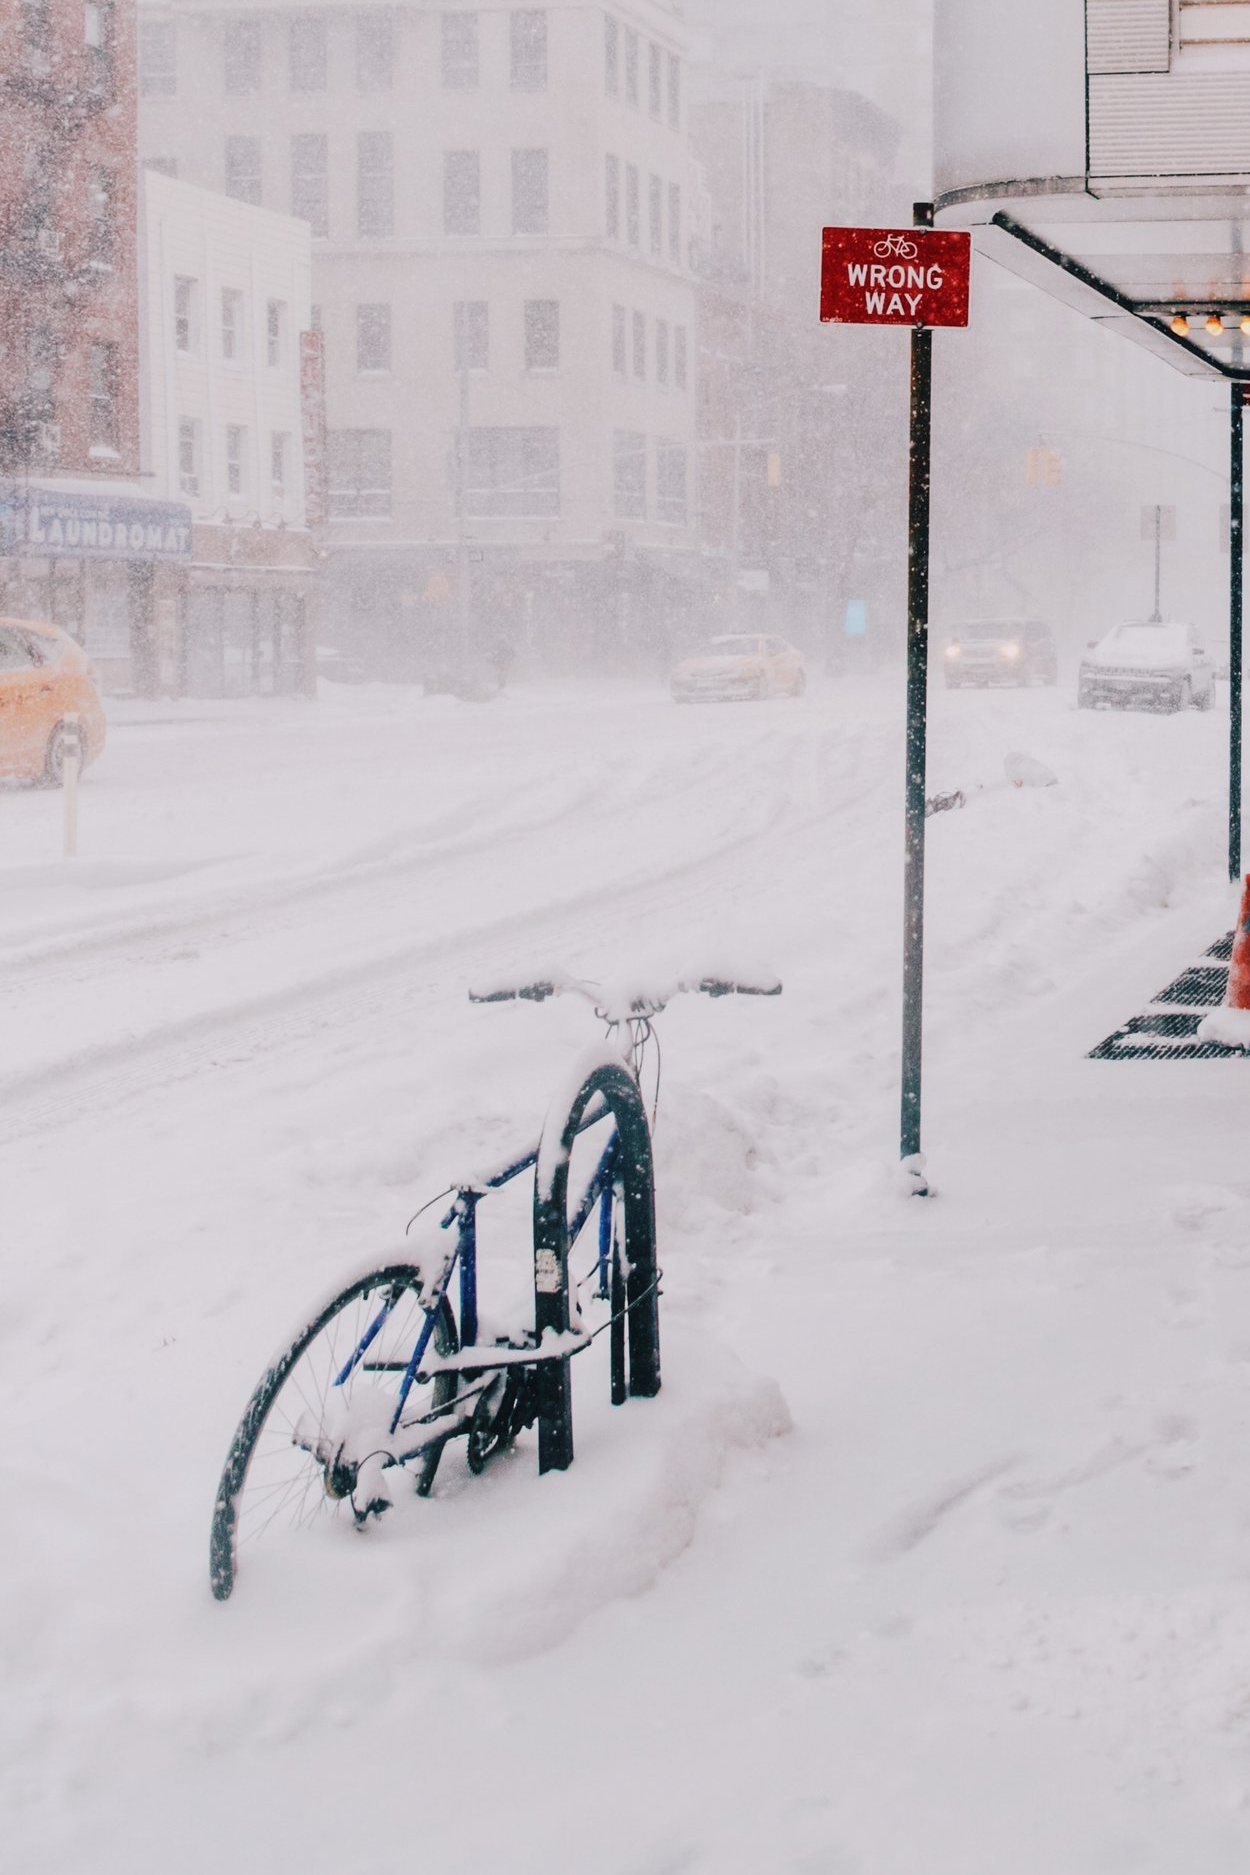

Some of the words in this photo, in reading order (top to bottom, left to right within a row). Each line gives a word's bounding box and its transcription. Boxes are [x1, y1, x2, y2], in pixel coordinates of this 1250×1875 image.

[847, 263, 943, 290] WRONG
[865, 291, 922, 316] WAY
[29, 505, 190, 552] LAUNDROMAT
